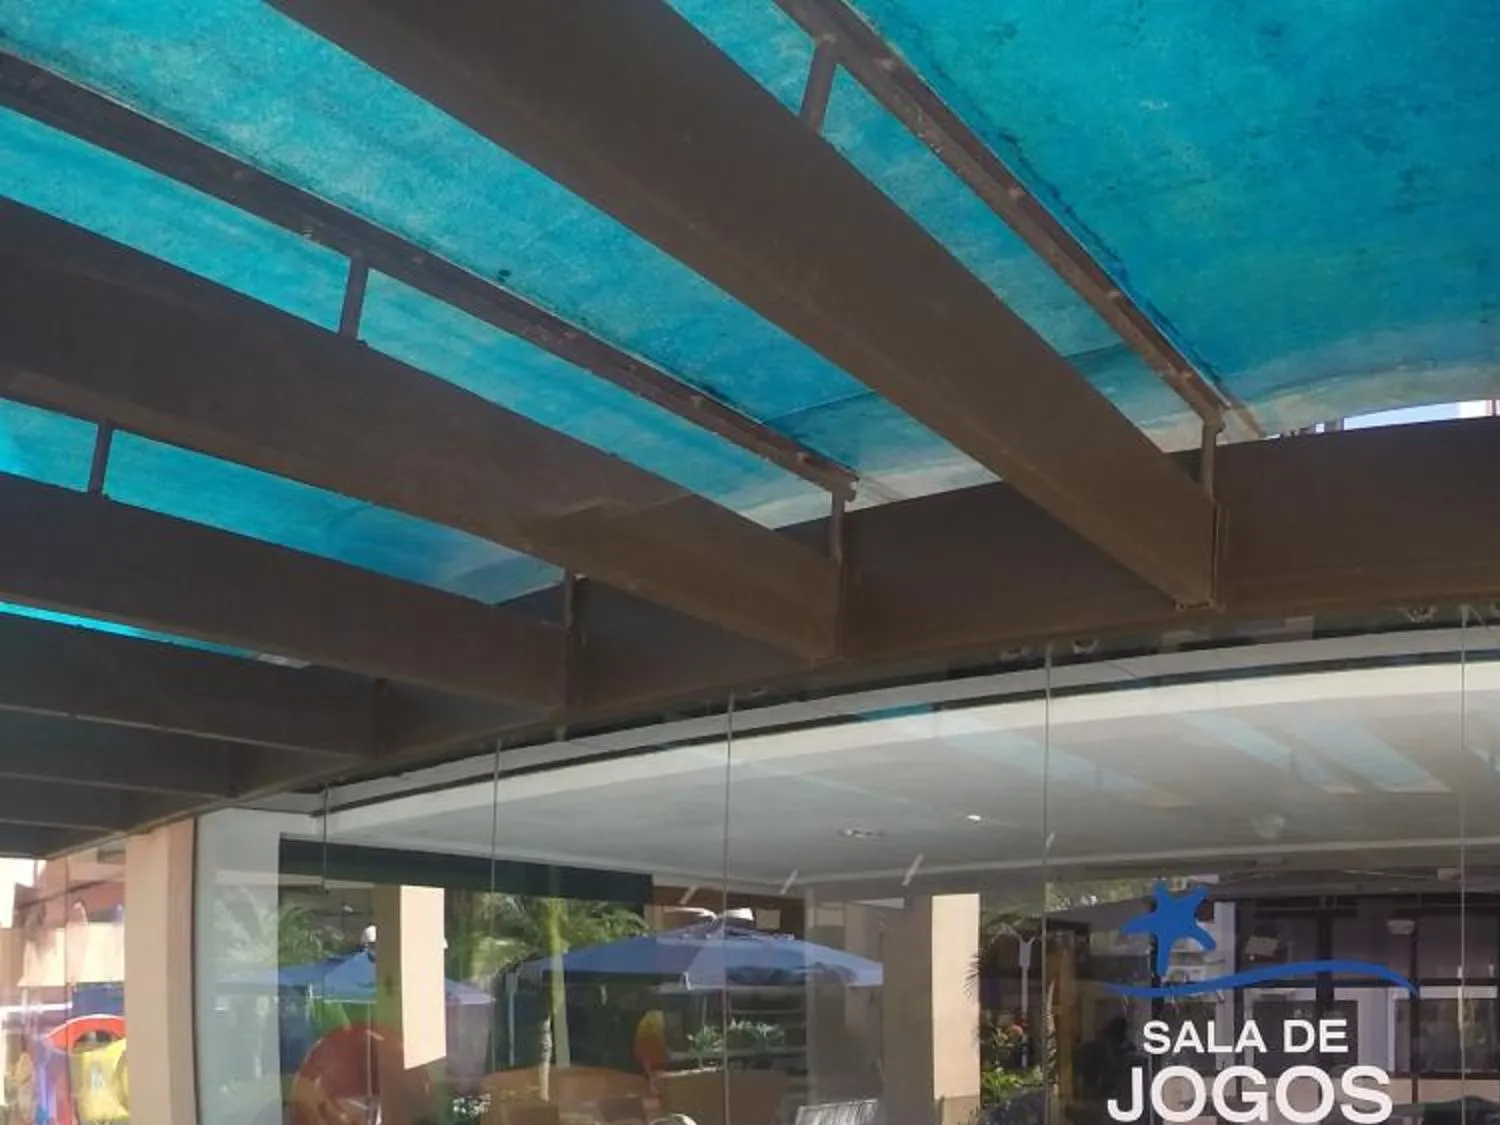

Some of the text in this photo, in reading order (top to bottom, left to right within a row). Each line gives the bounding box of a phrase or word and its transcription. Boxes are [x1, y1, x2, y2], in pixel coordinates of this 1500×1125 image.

[1143, 1019, 1349, 1054] SALA DE
[1107, 1065, 1393, 1124] JOGOS
